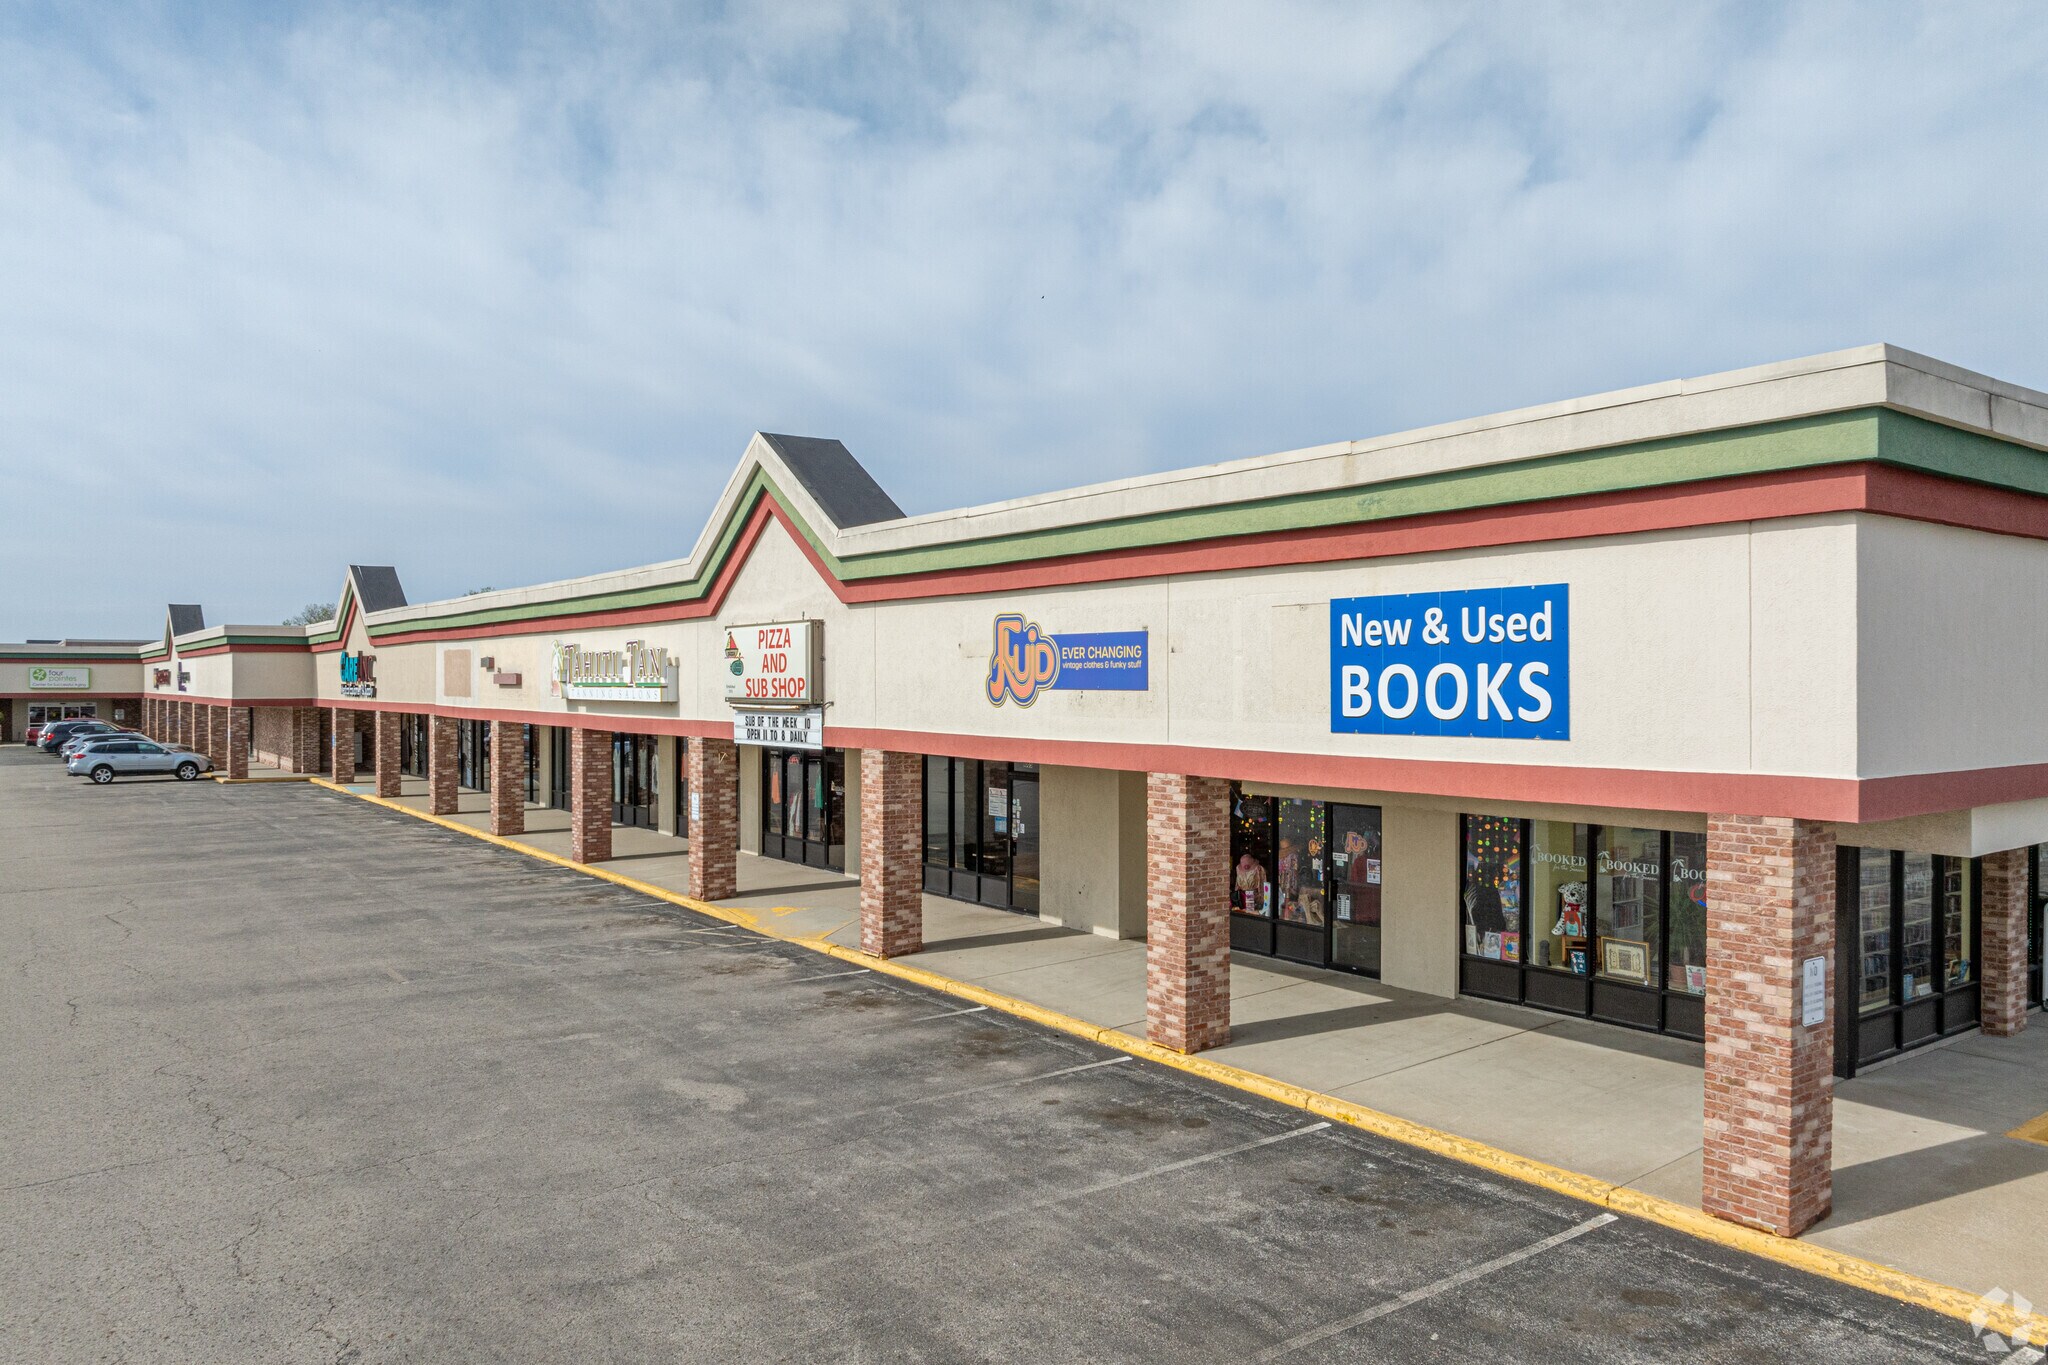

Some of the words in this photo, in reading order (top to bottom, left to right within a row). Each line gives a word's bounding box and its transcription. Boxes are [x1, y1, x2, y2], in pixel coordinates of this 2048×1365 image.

[1341, 612, 1412, 647] New
[1422, 607, 1450, 645] &
[1461, 600, 1552, 644] Used
[758, 627, 791, 650] PIZZA
[1062, 646, 1085, 659] EVER
[1087, 645, 1142, 659] CHANGING
[762, 652, 787, 674] AND
[1062, 661, 1082, 670] vintage
[1083, 661, 1104, 669] clothes
[1110, 660, 1127, 670] funky
[1127, 660, 1142, 669] stuff
[571, 688, 613, 698] TANNING
[619, 688, 658, 700] SALONS
[745, 677, 769, 698] SUB
[771, 677, 806, 698] SHOP
[1341, 661, 1553, 723] BOOKS
[745, 715, 755, 726] SUB
[757, 716, 764, 727] OF
[768, 717, 779, 728] THE
[747, 728, 760, 740] OPEN
[770, 730, 778, 741] TO
[781, 730, 786, 741] 8
[790, 730, 808, 742] DAILY
[1538, 852, 1587, 867] BOOKED
[1606, 860, 1660, 875] BOOKED
[1680, 868, 1707, 881] BOO
